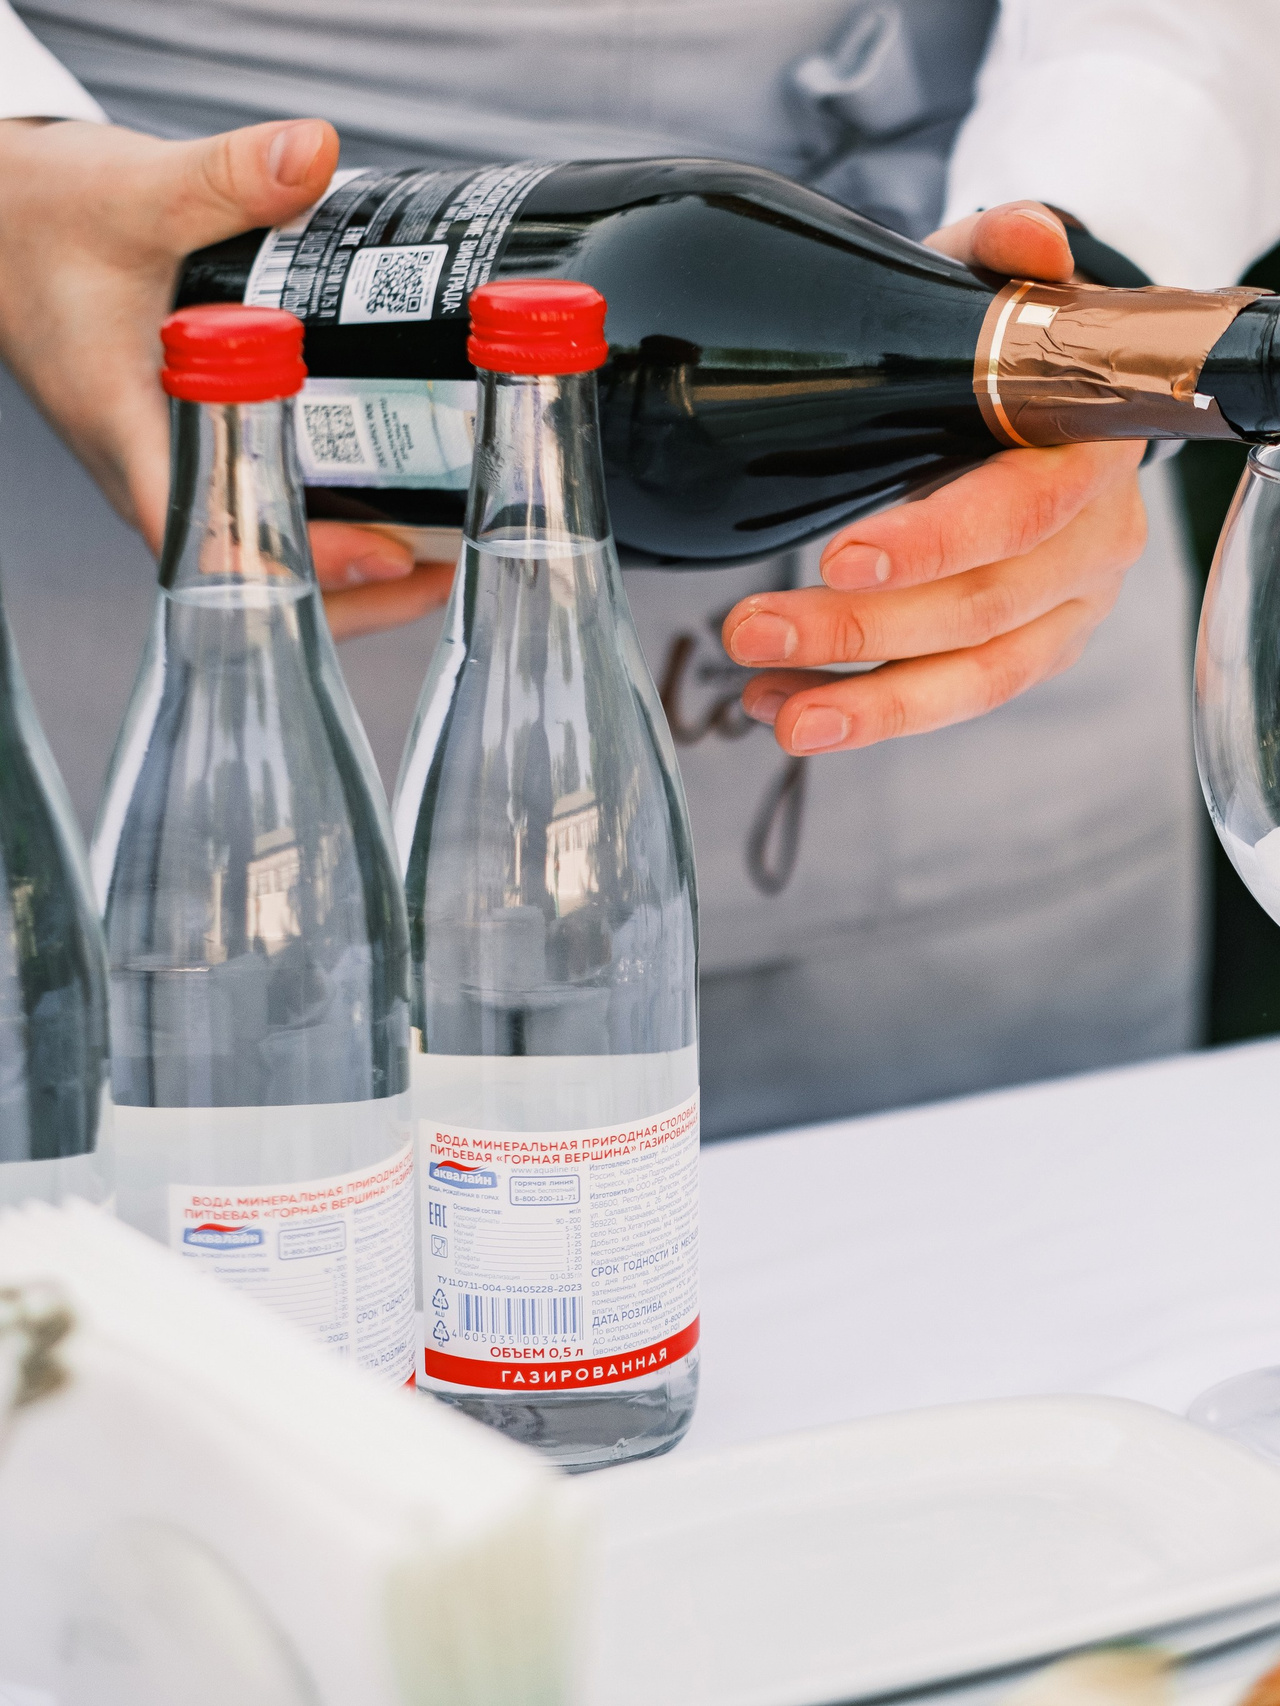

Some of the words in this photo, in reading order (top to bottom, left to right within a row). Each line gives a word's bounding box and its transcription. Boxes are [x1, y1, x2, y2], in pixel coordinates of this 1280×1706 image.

[441, 238, 484, 314] ВИНОГРАДА:
[436, 1132, 468, 1147] ВОДА
[472, 1138, 578, 1152] МИНЕРАЛЬНАЯ
[582, 1124, 657, 1149] ПРИРОДНАЯ
[659, 1102, 696, 1132] СТОЛОВАЯ
[430, 1144, 492, 1163] ПИТЬЕВАЯ
[496, 1154, 561, 1165] «ГОРНАЯ
[564, 1145, 637, 1164] ВЕРШИНА»
[433, 1167, 492, 1186] аквалайн
[191, 1195, 233, 1208] ВОДА
[236, 1185, 344, 1207] МИНЕРАЛЬНАЯ
[346, 1160, 403, 1192] ПРИРОДНАЯ
[514, 1180, 547, 1188] горячая
[184, 1207, 260, 1220] ПИТЬЕВАЯ
[263, 1202, 328, 1219] «ГОРНАЯ
[331, 1184, 391, 1211] ВЕРШИНА»
[453, 1203, 481, 1214] Основной
[607, 1225, 627, 1236] Коста
[590, 1237, 619, 1249] Добыто
[591, 1263, 620, 1278] СРОК
[623, 1248, 669, 1272] ГОДНОСТИ
[671, 1243, 679, 1256] 18
[437, 1275, 448, 1285] ТУ
[616, 1303, 630, 1312] при
[592, 1313, 620, 1329] ДАТА
[621, 1300, 663, 1321] РОЗЛИВА
[592, 1328, 604, 1336] По
[605, 1322, 641, 1336] вопросам
[464, 1333, 515, 1345] 605035
[523, 1333, 577, 1346] 003444
[592, 1337, 606, 1346] АО
[490, 1346, 545, 1359] ОБЪЕМ
[549, 1347, 572, 1359] 0,5
[574, 1348, 584, 1357] л
[592, 1345, 622, 1356] (звонок
[501, 1347, 668, 1384] ГАЗИРОВАННАЯ
